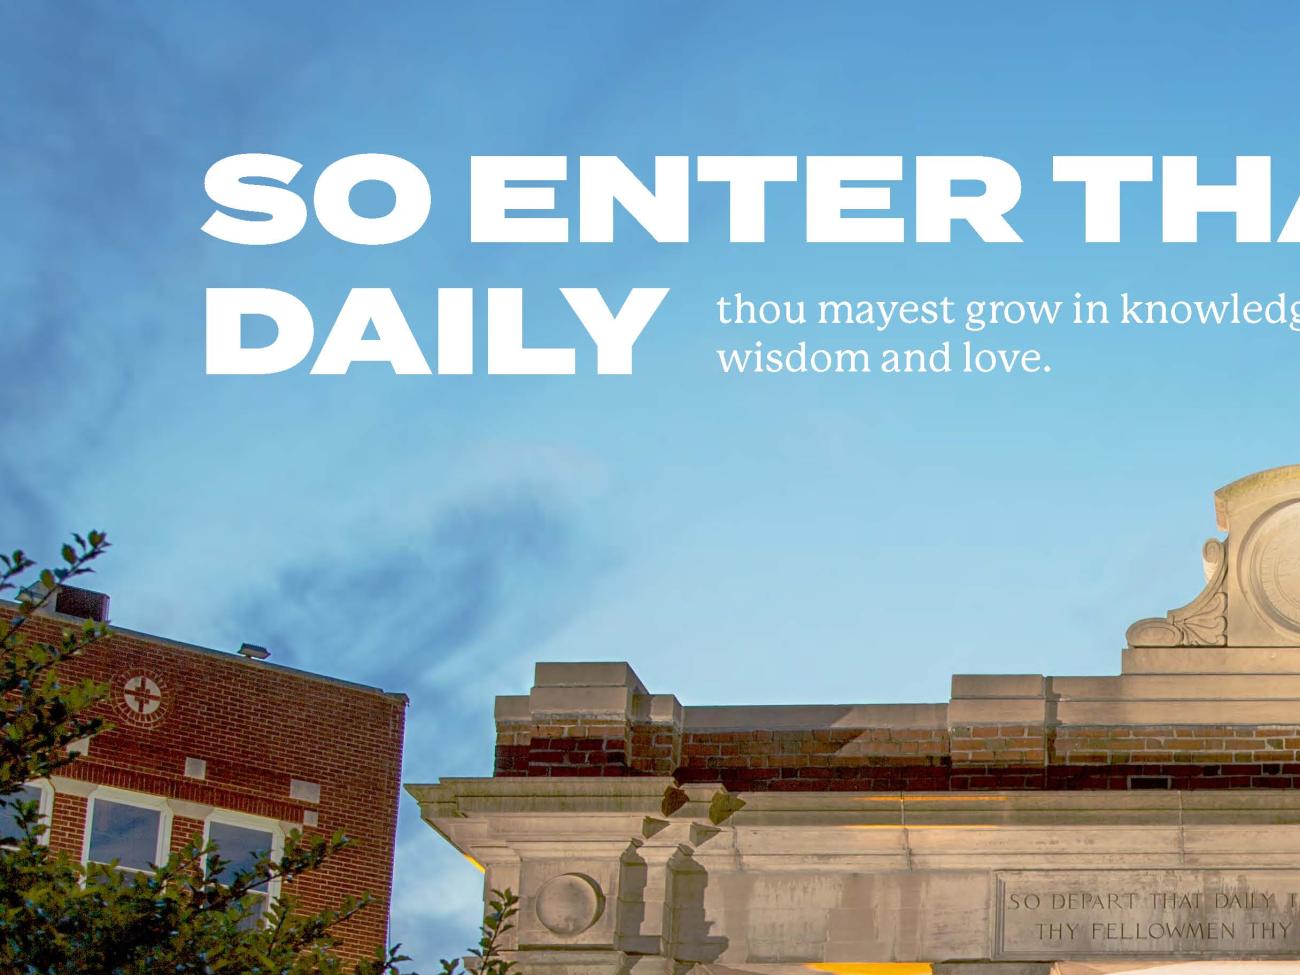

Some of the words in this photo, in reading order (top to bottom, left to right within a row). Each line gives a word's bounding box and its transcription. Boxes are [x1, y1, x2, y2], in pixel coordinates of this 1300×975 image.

[1008, 892, 1041, 910] SO
[1051, 892, 1138, 910] DEPART
[1151, 892, 1203, 910] THAT
[1214, 892, 1276, 910] DAILY
[1034, 922, 1080, 940] THY
[1092, 922, 1236, 940] FELLOWMEN
[1250, 922, 1293, 940] THY
